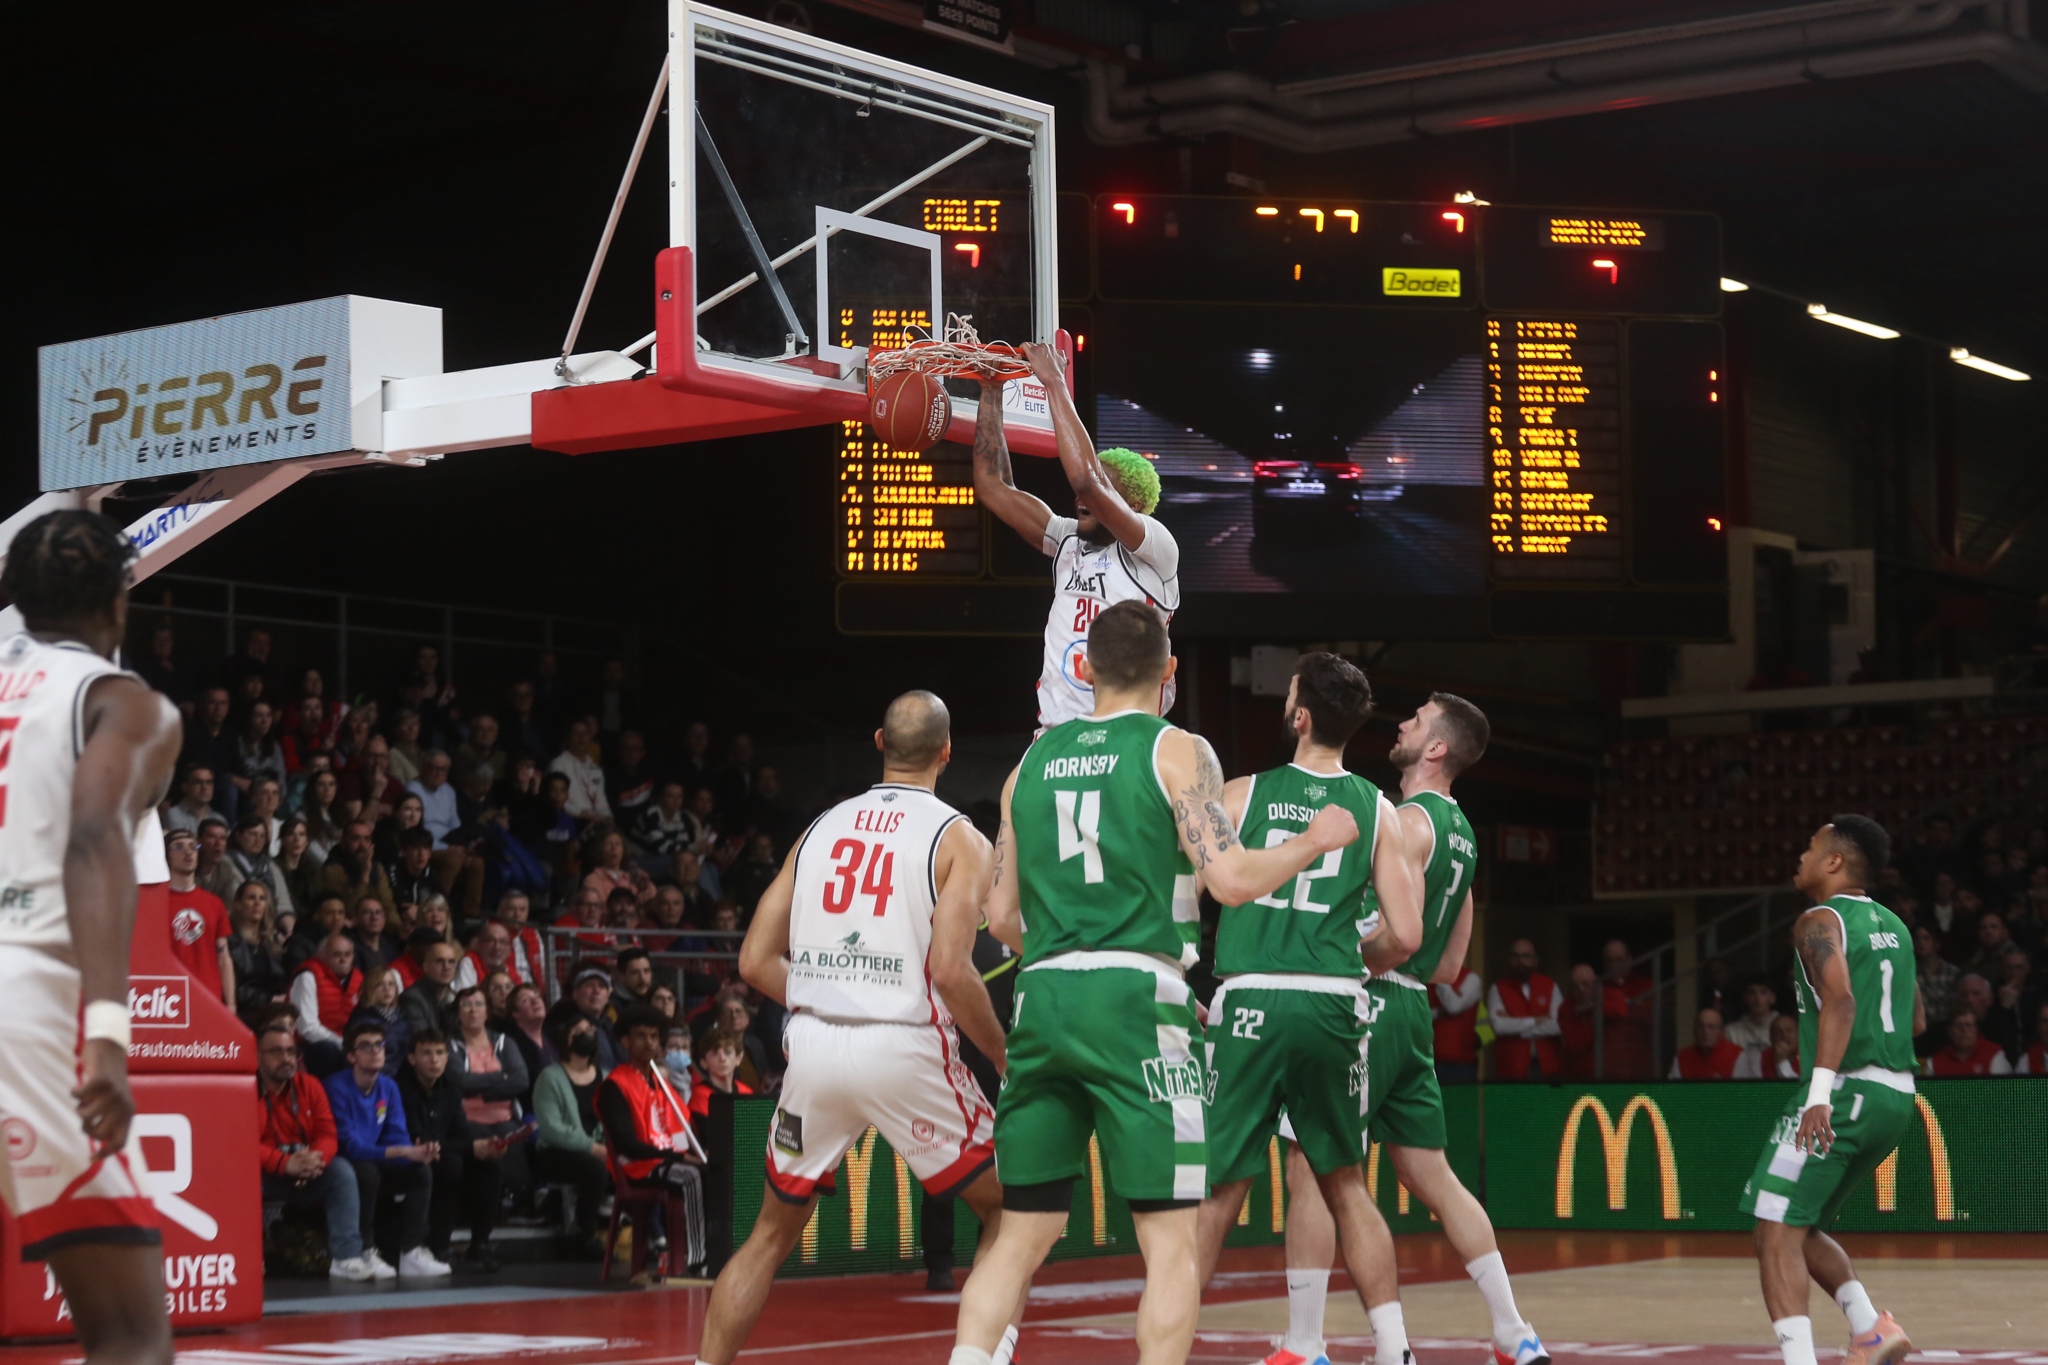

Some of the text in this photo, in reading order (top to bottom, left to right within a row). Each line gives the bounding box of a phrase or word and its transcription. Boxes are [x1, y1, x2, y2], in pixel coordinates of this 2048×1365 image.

[965, 13, 1000, 35] POINTS
[1387, 271, 1459, 292] Bodet
[1024, 385, 1046, 398] Betclic
[1043, 754, 1120, 781] HORNSBY
[854, 809, 905, 834] ELLIS
[1267, 802, 1323, 824] DUSSO
[1054, 789, 1105, 885] 4
[822, 838, 895, 918] 34
[791, 950, 904, 974] LA BLOTTIERE
[863, 973, 903, 987] Poires
[1370, 995, 1386, 1024] 7
[1879, 959, 1896, 1034] 1
[1232, 1007, 1265, 1041] 22
[1849, 1093, 1864, 1122] 1
[162, 1253, 238, 1289] UYER
